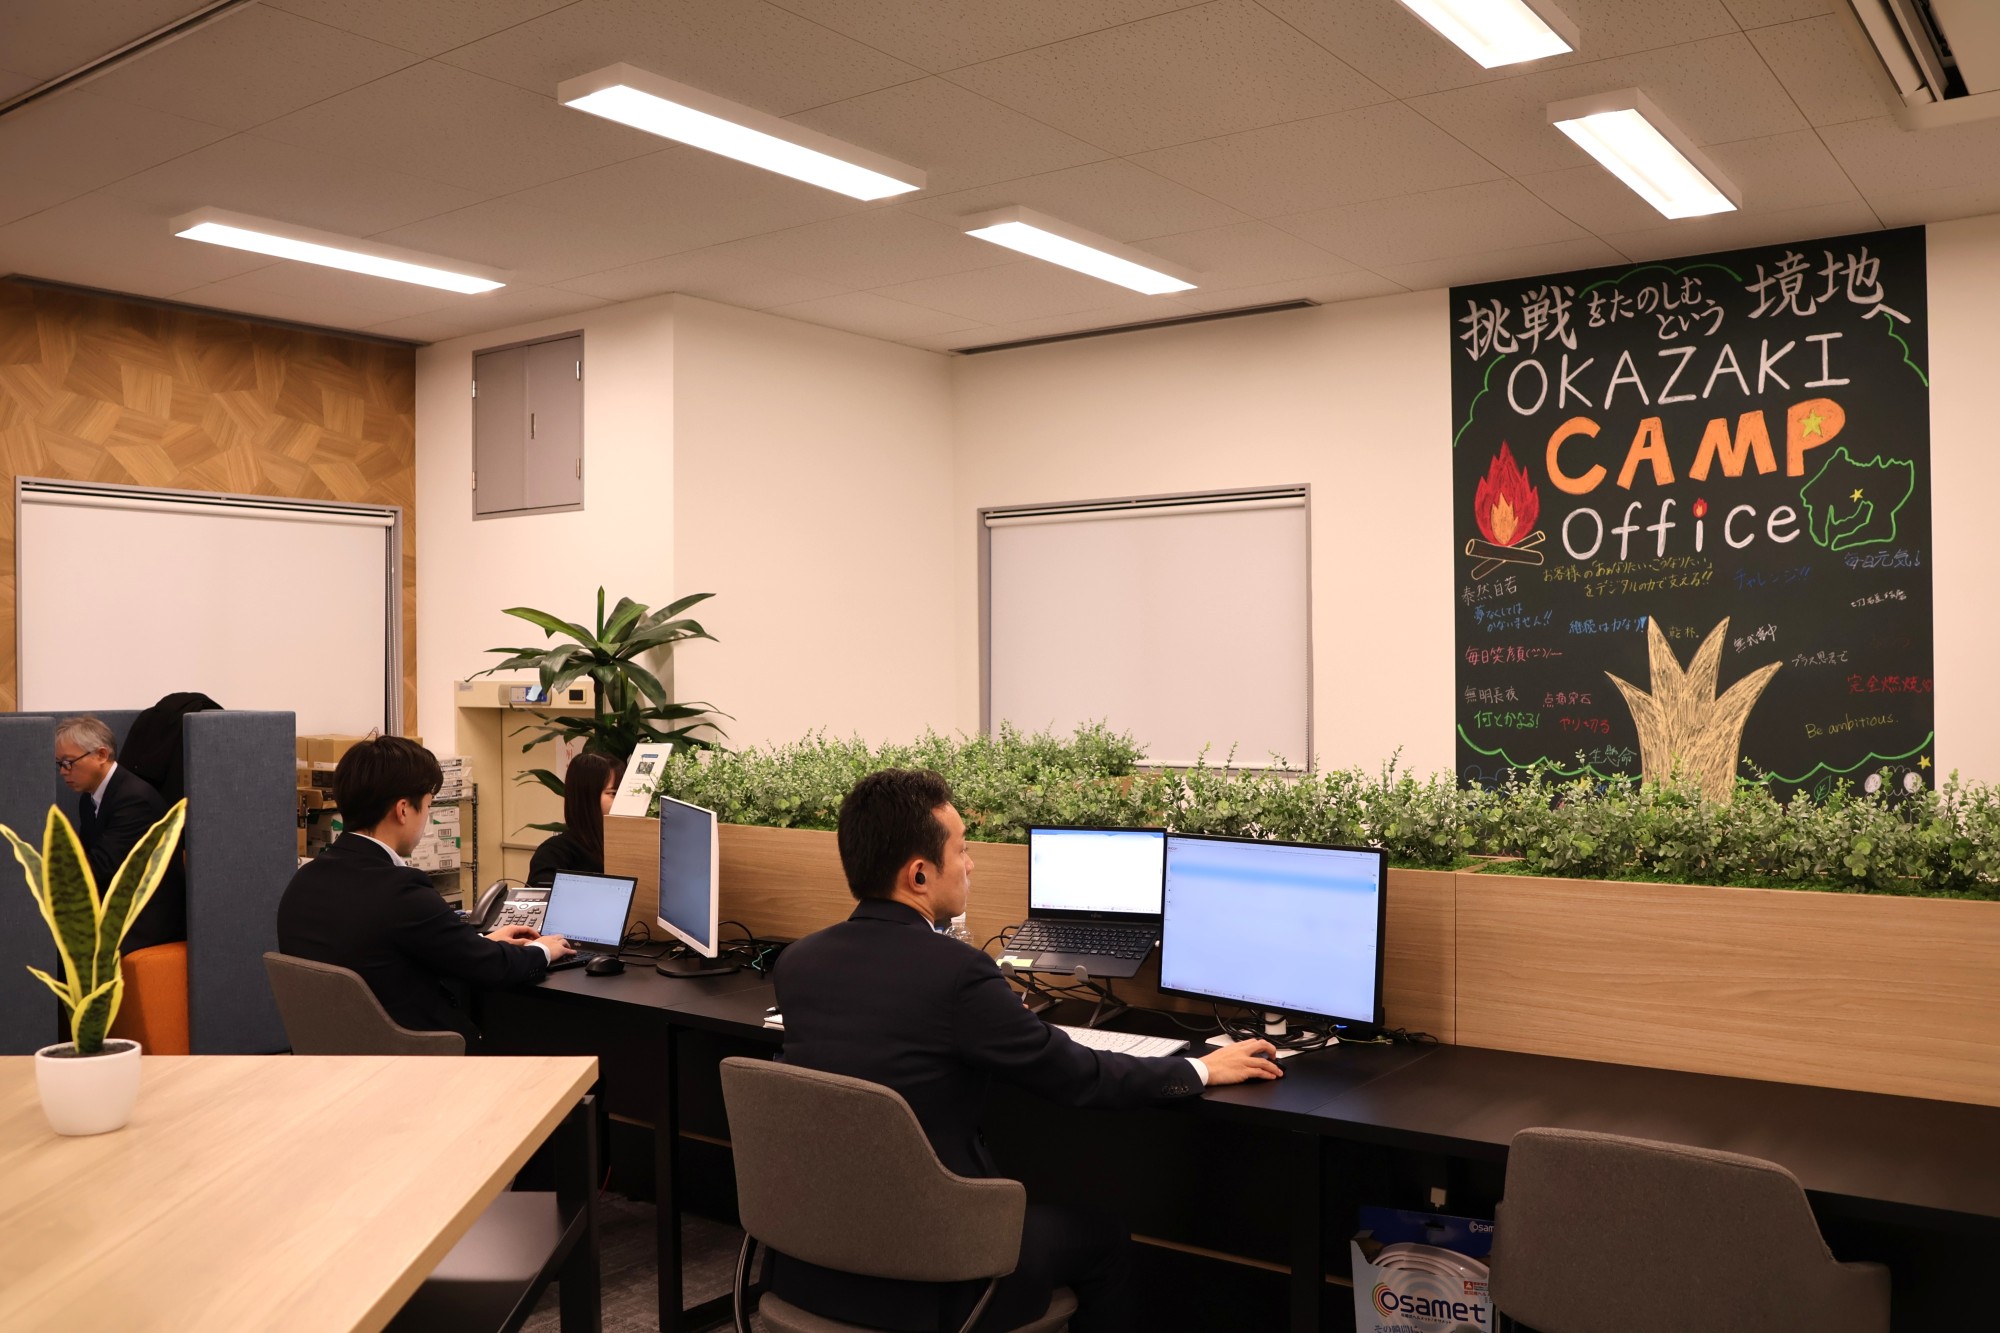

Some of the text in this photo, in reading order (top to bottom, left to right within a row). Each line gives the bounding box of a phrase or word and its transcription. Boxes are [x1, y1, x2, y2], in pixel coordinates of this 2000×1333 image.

[1458, 284, 1578, 362] 挑戦
[1587, 276, 1703, 328] をたのしむ
[1657, 299, 1726, 341] という
[1506, 331, 1851, 417] OKAZAKI
[1545, 397, 1847, 495] CAMP
[1461, 575, 1518, 607] 泰然自若
[1464, 685, 1519, 704] 無明長夜
[1560, 717, 1611, 735] やり切る
[1805, 723, 1824, 739] Be
